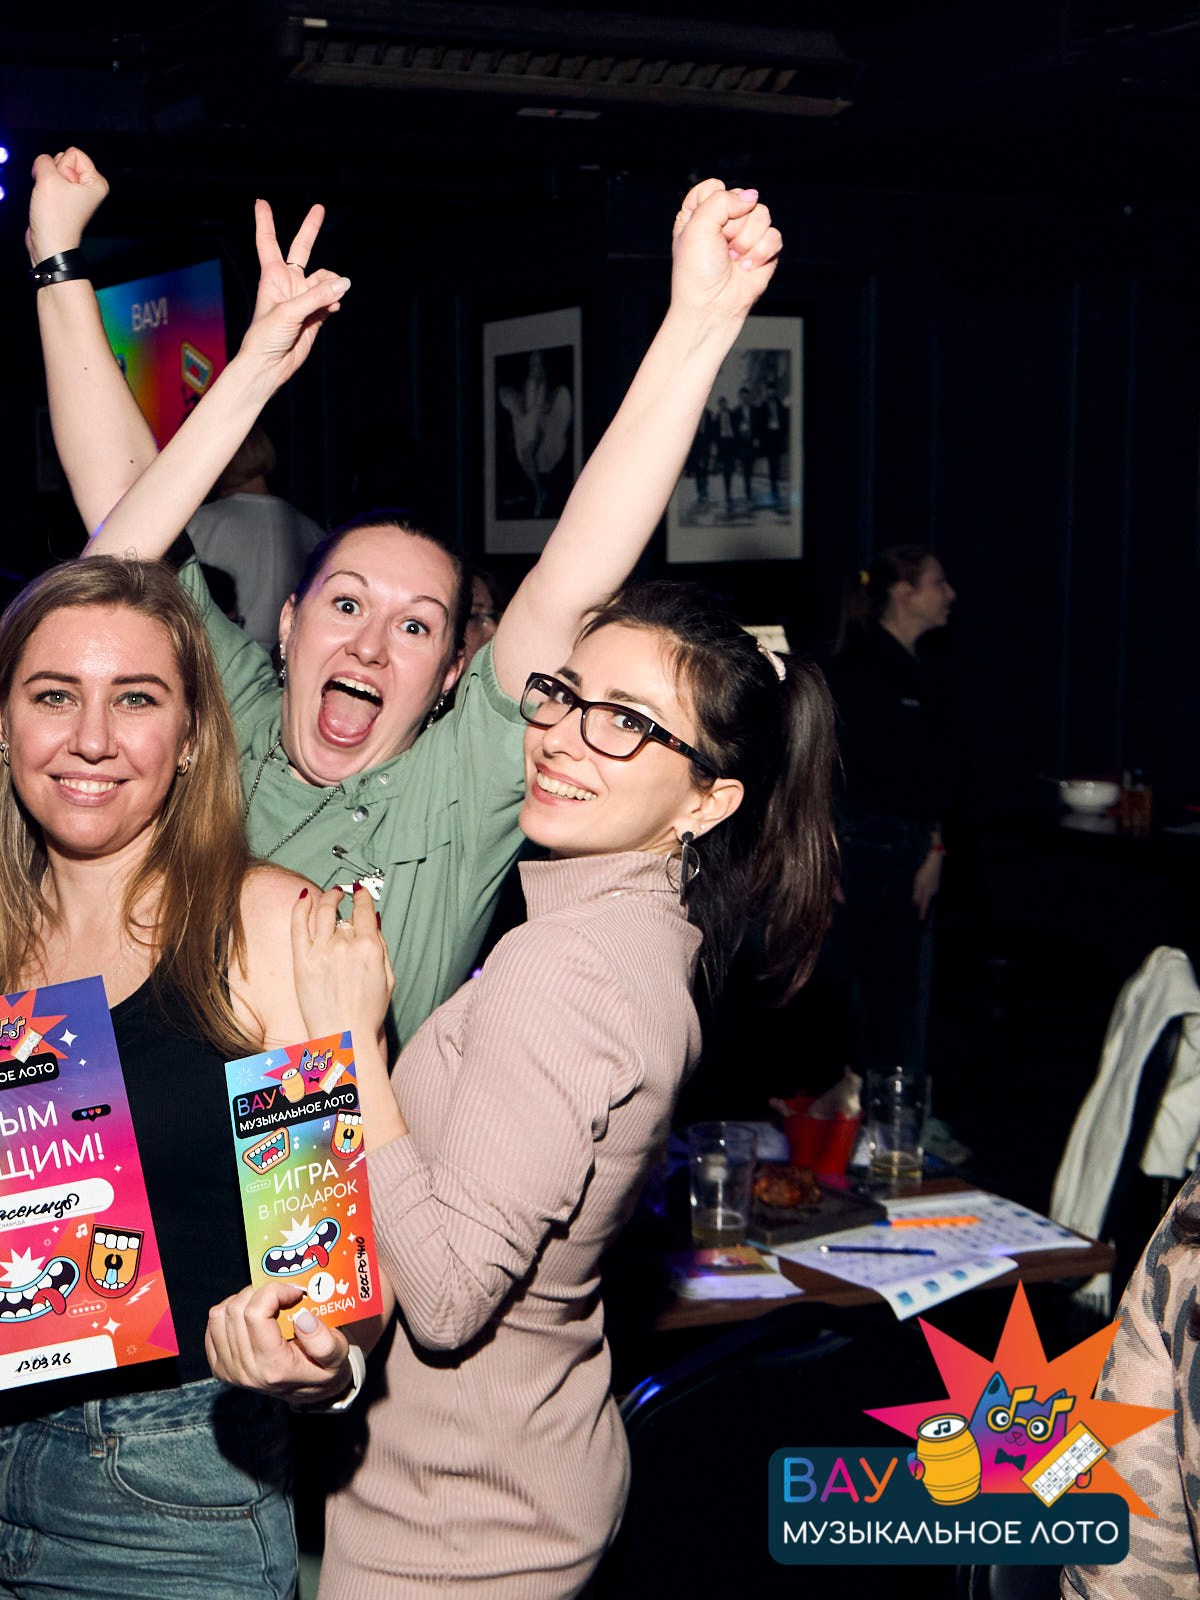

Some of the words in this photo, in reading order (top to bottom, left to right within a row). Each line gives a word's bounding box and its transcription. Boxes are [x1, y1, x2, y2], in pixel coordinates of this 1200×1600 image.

[131, 297, 168, 332] ВАУ!
[19, 1062, 55, 1079] ЛОТО
[237, 1089, 276, 1117] ВАУ
[239, 1101, 322, 1132] МУЗЫКАЛЬНОЕ
[324, 1093, 355, 1110] ЛОТО
[273, 1159, 339, 1194] ИГРА
[258, 1204, 269, 1220] В
[273, 1179, 359, 1216] ПОДАРОК
[314, 1277, 322, 1295] 1
